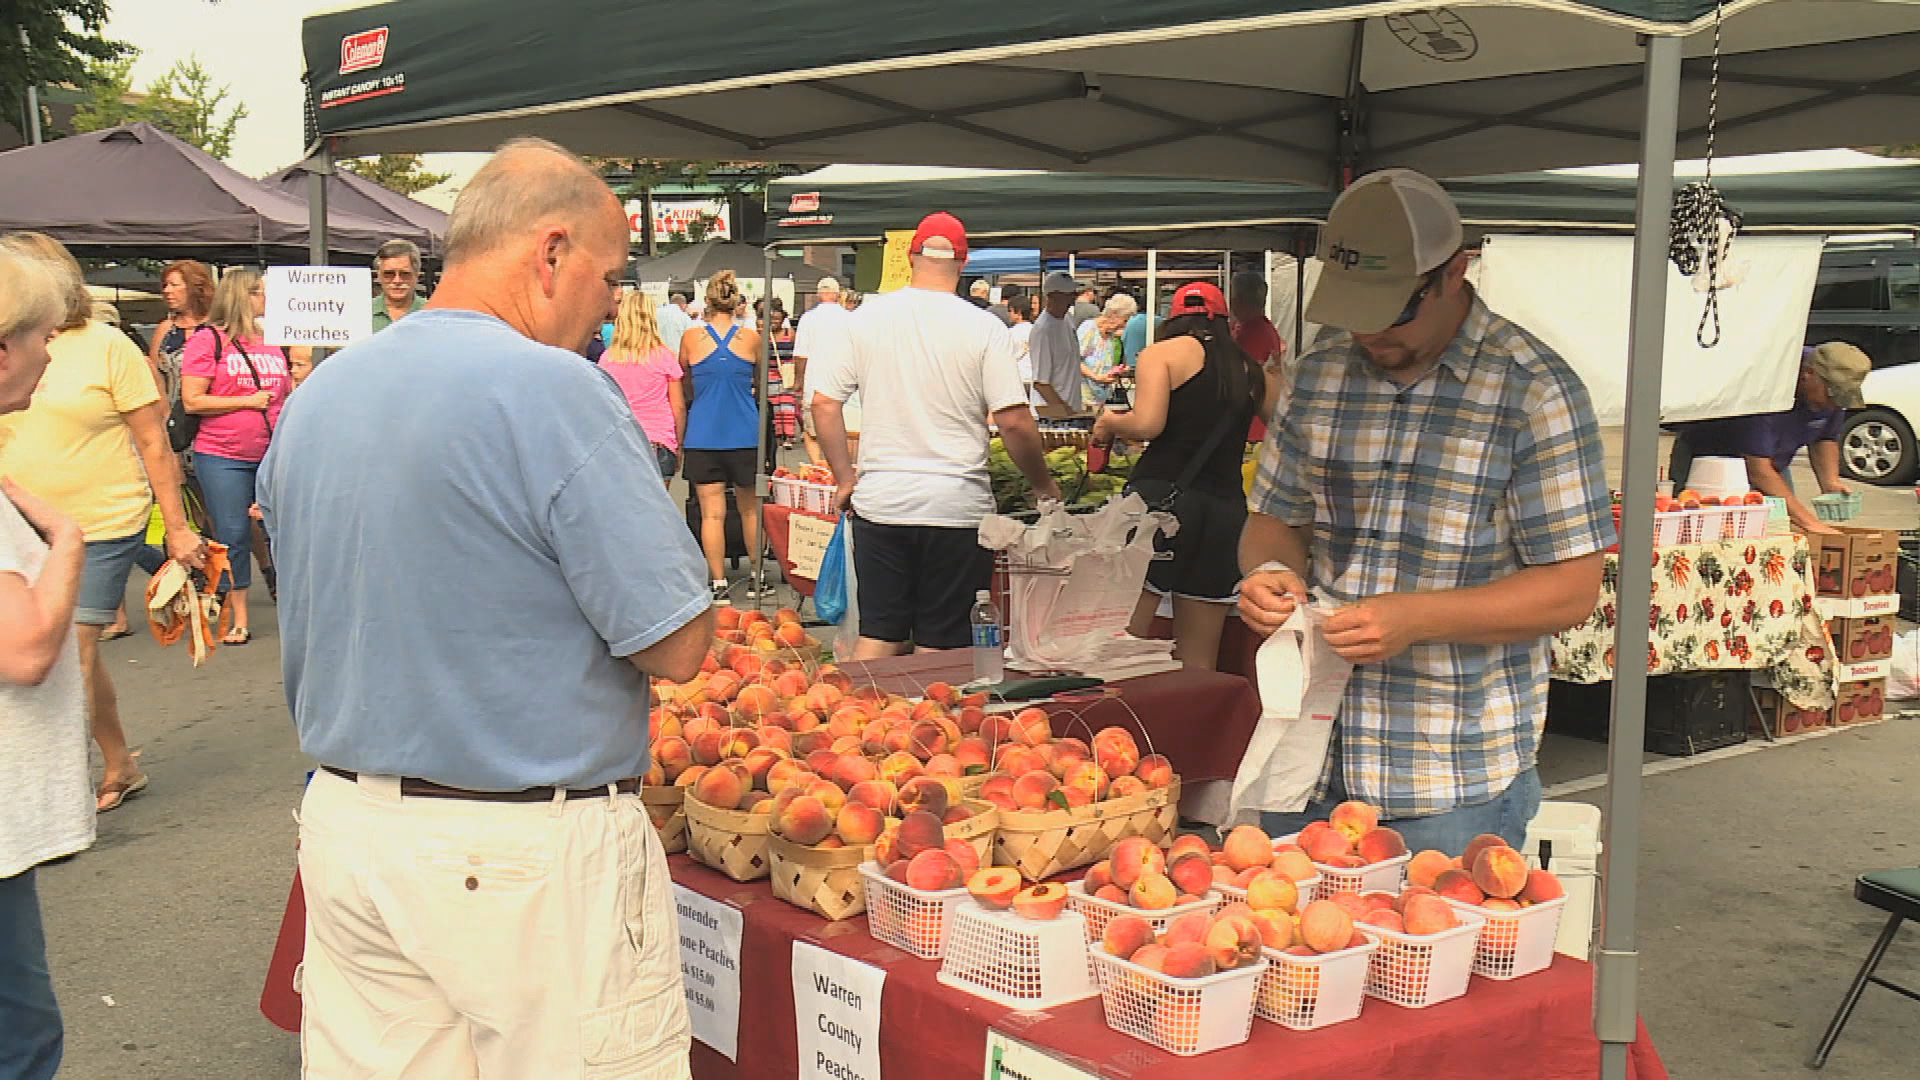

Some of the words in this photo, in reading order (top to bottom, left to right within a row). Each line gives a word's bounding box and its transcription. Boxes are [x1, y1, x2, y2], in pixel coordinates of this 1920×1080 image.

[350, 79, 380, 95] CANOPY
[287, 269, 347, 285] Warren
[287, 297, 345, 316] County
[283, 325, 350, 340] Peaches
[676, 899, 719, 931] ontender
[699, 939, 735, 971] Peaches
[813, 971, 862, 1011] Warren
[818, 1013, 862, 1055] County
[816, 1049, 866, 1080] Peach
